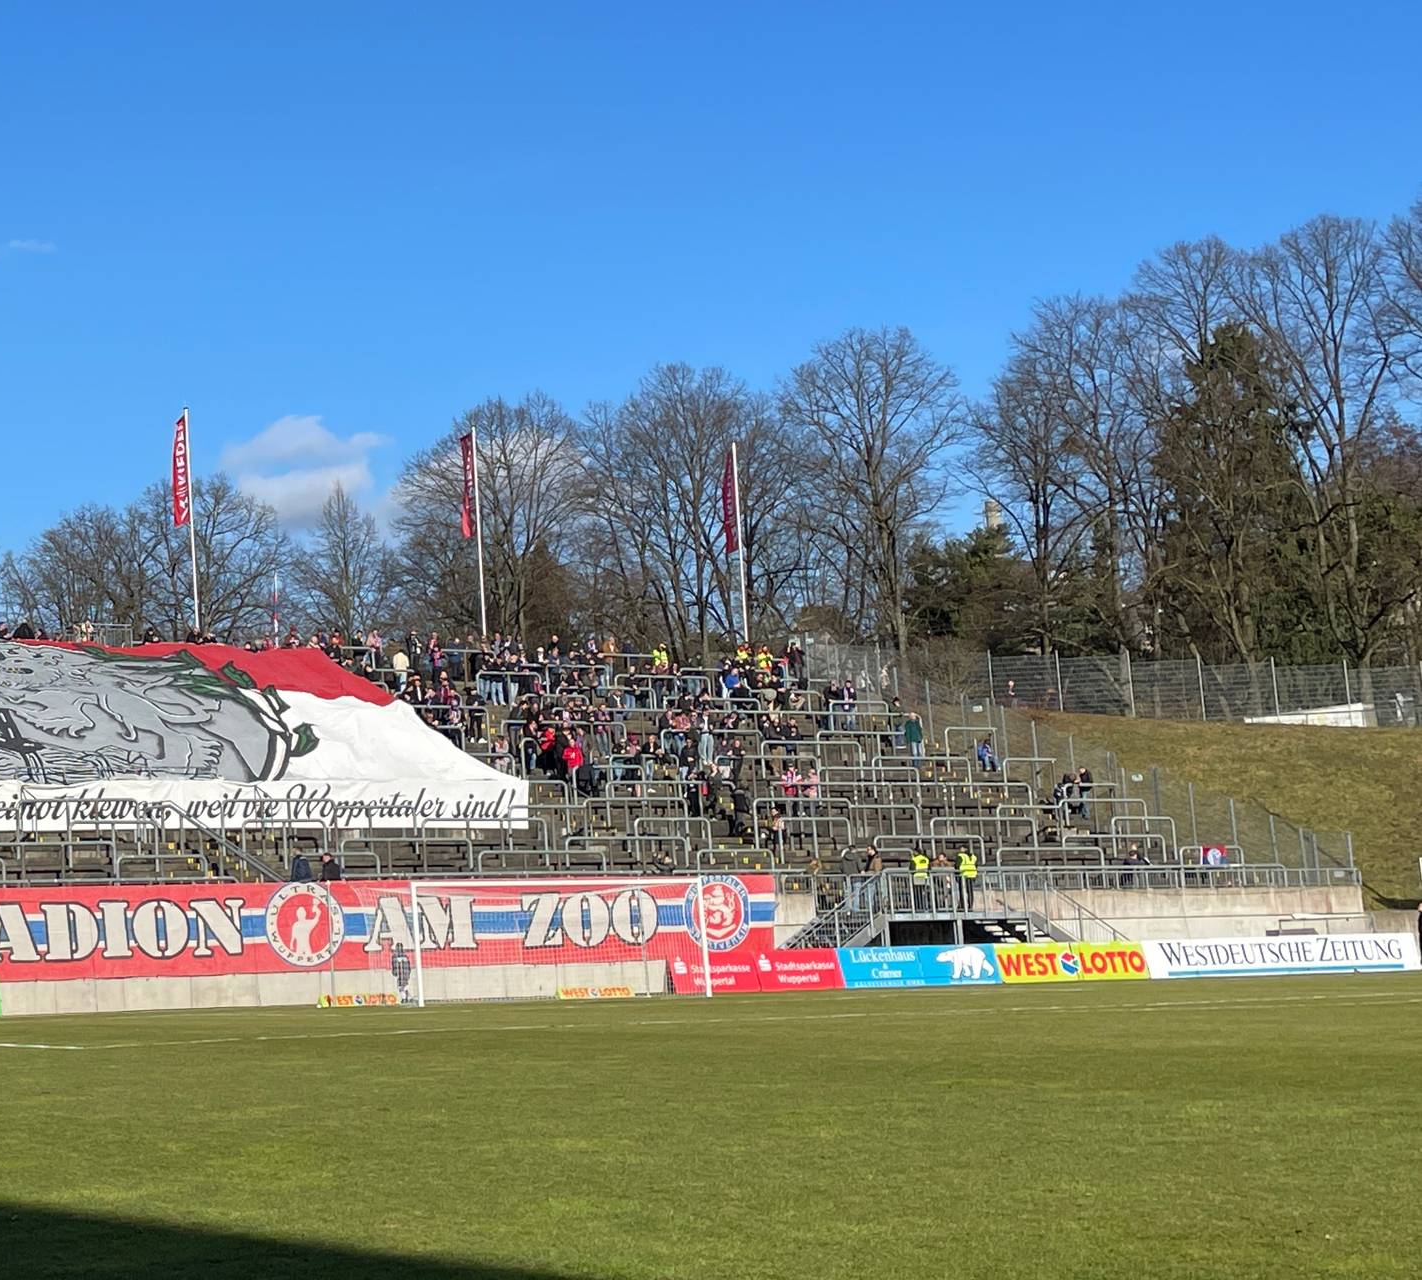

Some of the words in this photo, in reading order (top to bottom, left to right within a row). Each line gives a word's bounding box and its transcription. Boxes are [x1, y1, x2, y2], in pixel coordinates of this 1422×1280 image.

[452, 788, 516, 819] sind!
[363, 893, 478, 952] AM
[520, 888, 659, 949] ZOO
[775, 961, 835, 972] Stadtsparkasse
[997, 953, 1058, 977] WEST
[1080, 950, 1145, 974] LOTTO
[778, 973, 821, 985] Wuppertal
